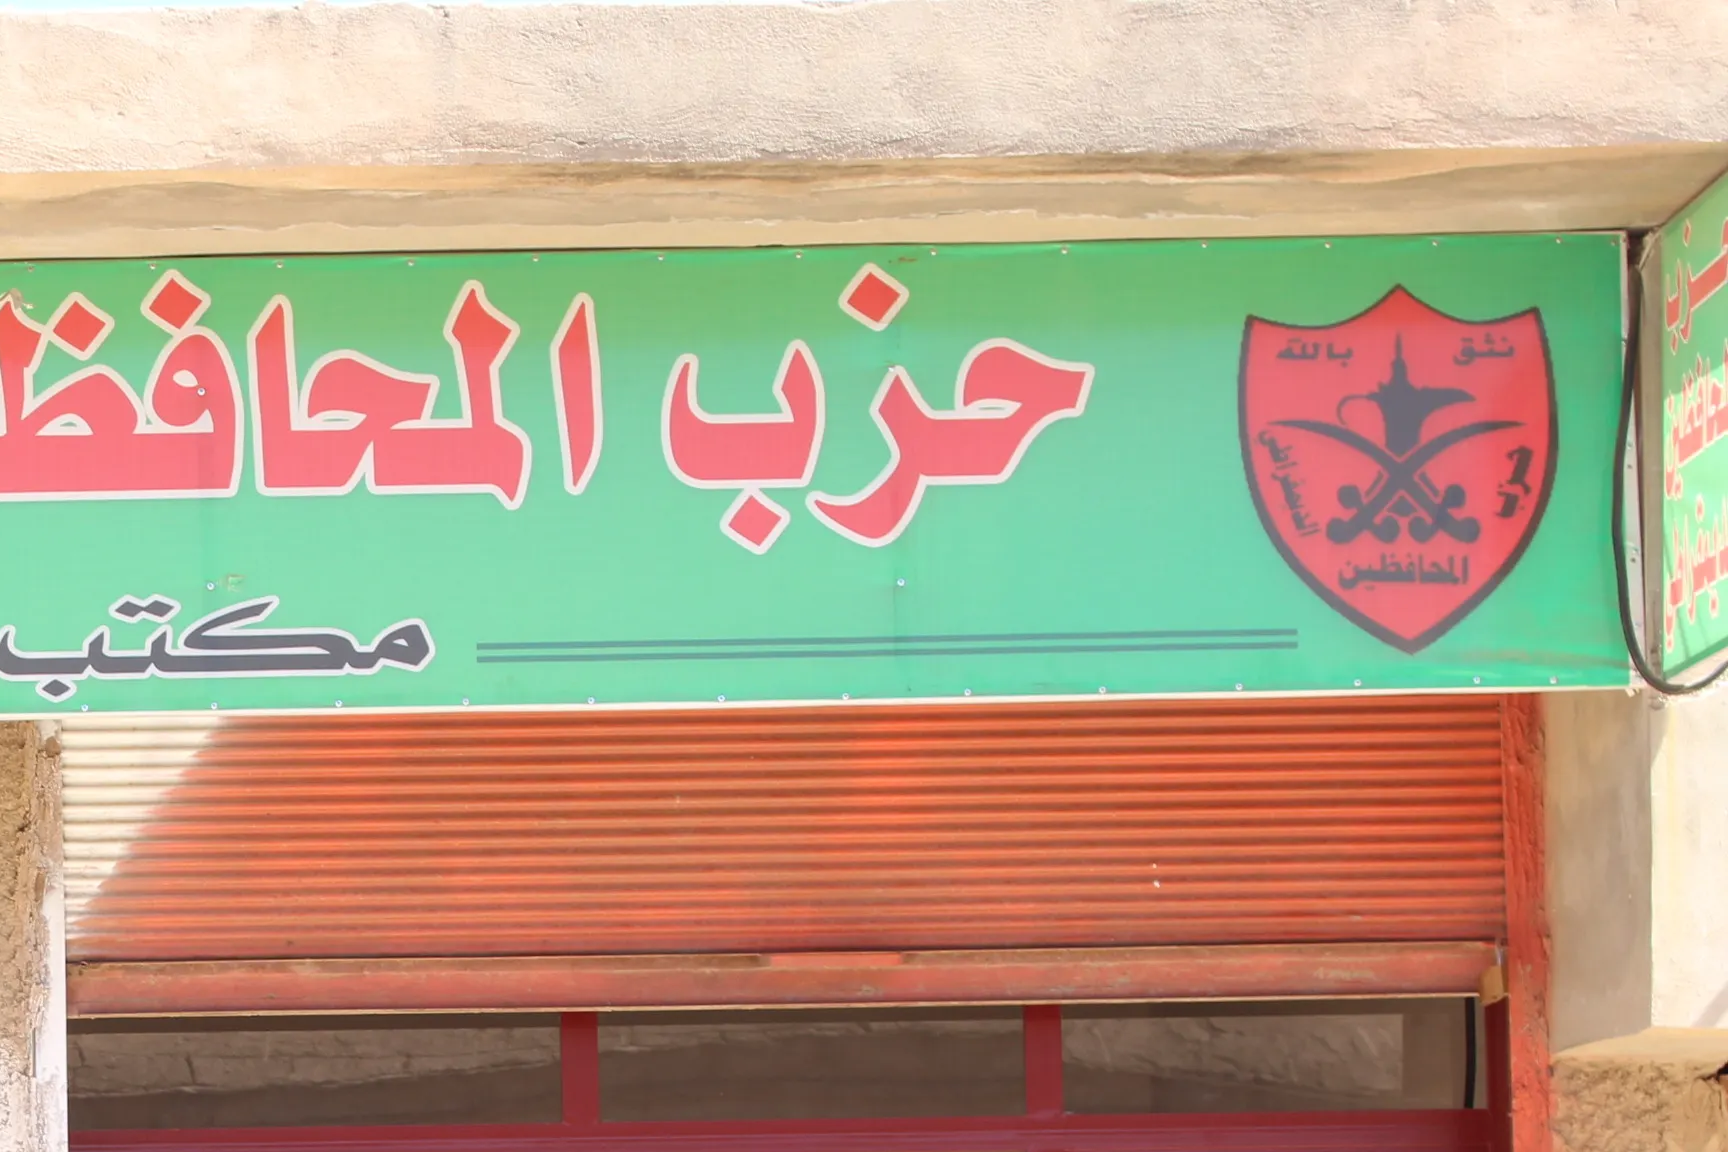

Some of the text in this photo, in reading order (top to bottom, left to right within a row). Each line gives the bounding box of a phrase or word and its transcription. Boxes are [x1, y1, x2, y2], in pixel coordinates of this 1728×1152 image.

[1664, 217, 1728, 354] زب
[1276, 332, 1515, 368] نثق بالله
[664, 266, 1092, 551] حزب
[1494, 445, 1534, 519] حزب
[1337, 551, 1470, 592] المحافظين
